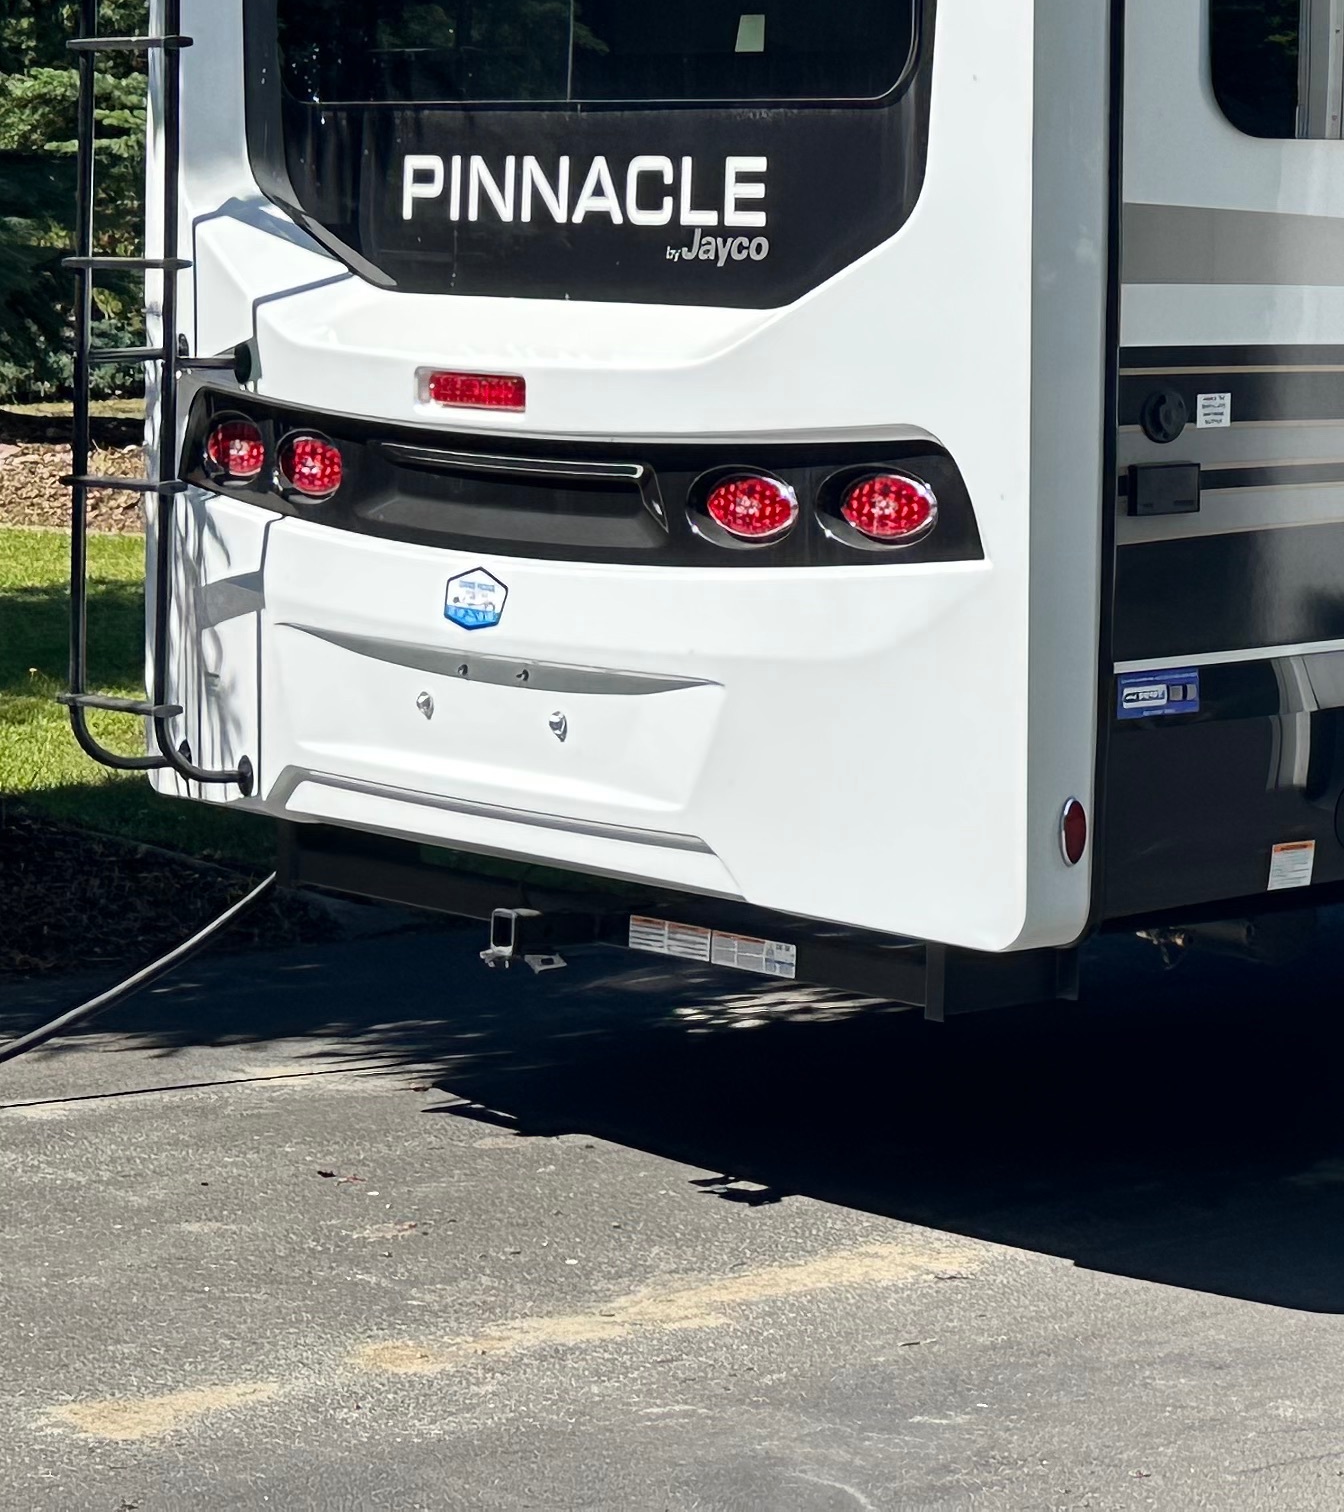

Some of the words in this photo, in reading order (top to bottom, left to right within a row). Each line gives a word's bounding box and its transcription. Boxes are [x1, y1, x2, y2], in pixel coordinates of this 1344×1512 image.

[402, 154, 768, 227] PINNACLE
[665, 245, 681, 263] by
[681, 227, 770, 268] Jayco
